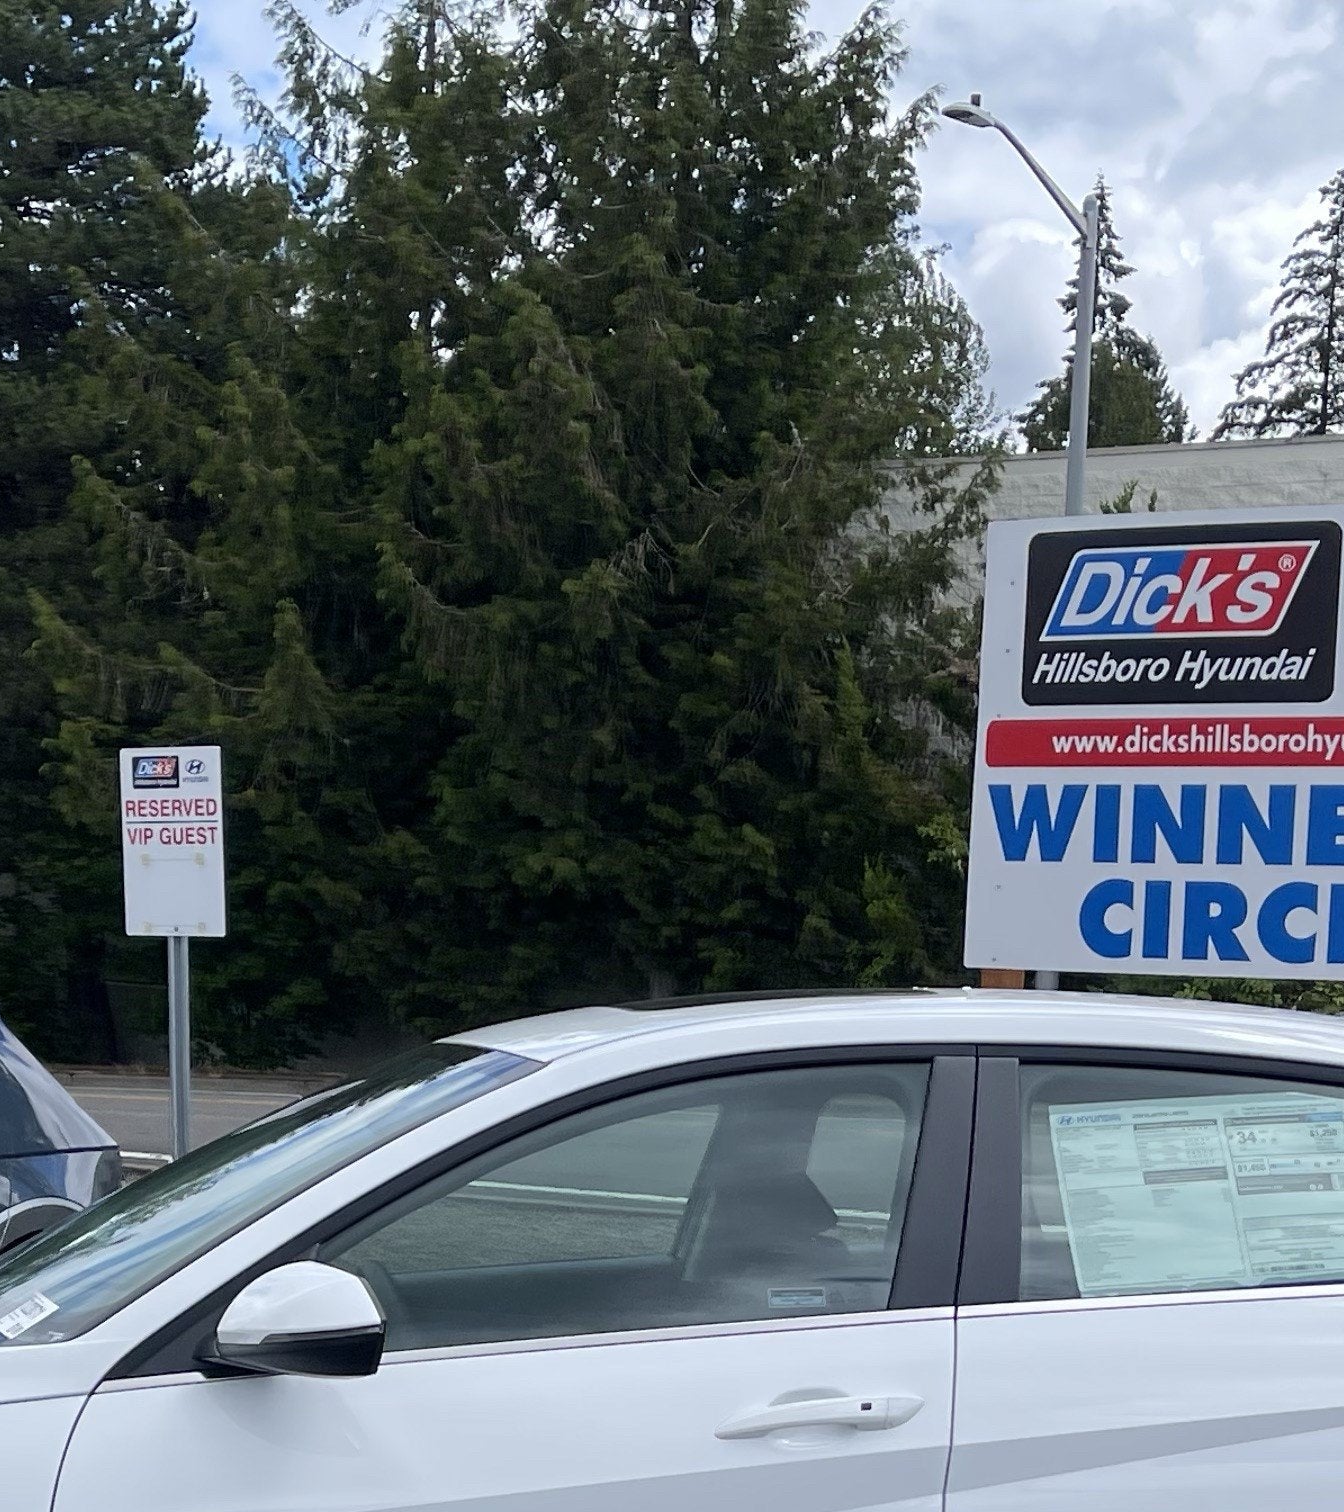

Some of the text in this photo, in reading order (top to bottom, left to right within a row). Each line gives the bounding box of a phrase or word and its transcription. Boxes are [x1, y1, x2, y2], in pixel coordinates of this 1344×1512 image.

[1032, 648, 1317, 690] Hillsboro Hyundai
[125, 798, 218, 817] RESERVED
[127, 826, 218, 845] VIP GUEST
